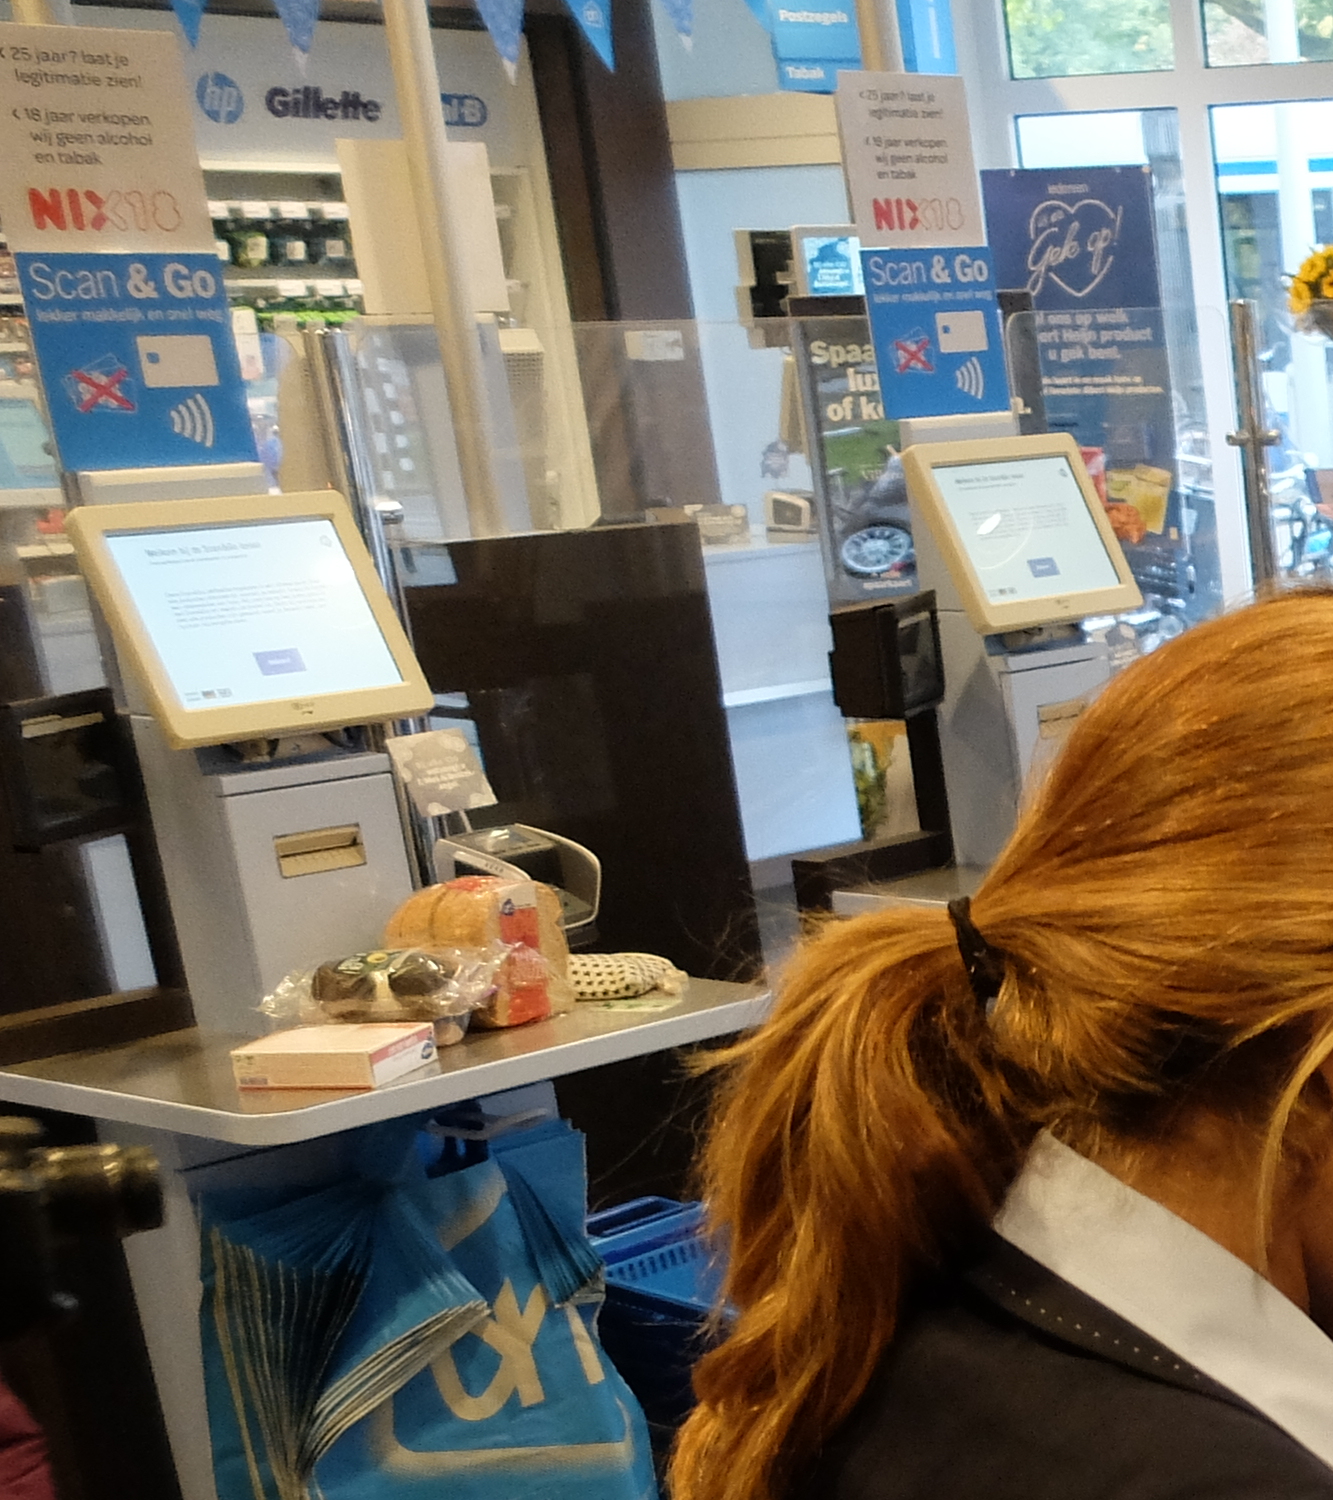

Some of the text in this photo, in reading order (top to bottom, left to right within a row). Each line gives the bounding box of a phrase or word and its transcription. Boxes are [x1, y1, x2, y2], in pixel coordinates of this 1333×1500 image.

[779, 9, 848, 25] Postzegels
[10, 46, 31, 61] 25
[15, 68, 101, 87] legitimatie
[786, 66, 825, 79] Tabak
[265, 86, 382, 122] Gillette
[23, 107, 42, 122] 18
[43, 109, 75, 126] jaar
[30, 130, 153, 147] wij geen alcohol
[34, 151, 103, 165] en tabak
[869, 256, 927, 286] Scan
[931, 255, 951, 283] &
[955, 254, 989, 283] Go
[29, 262, 216, 300] Scan & Go
[810, 341, 874, 367] Spaa
[827, 397, 853, 421] of
